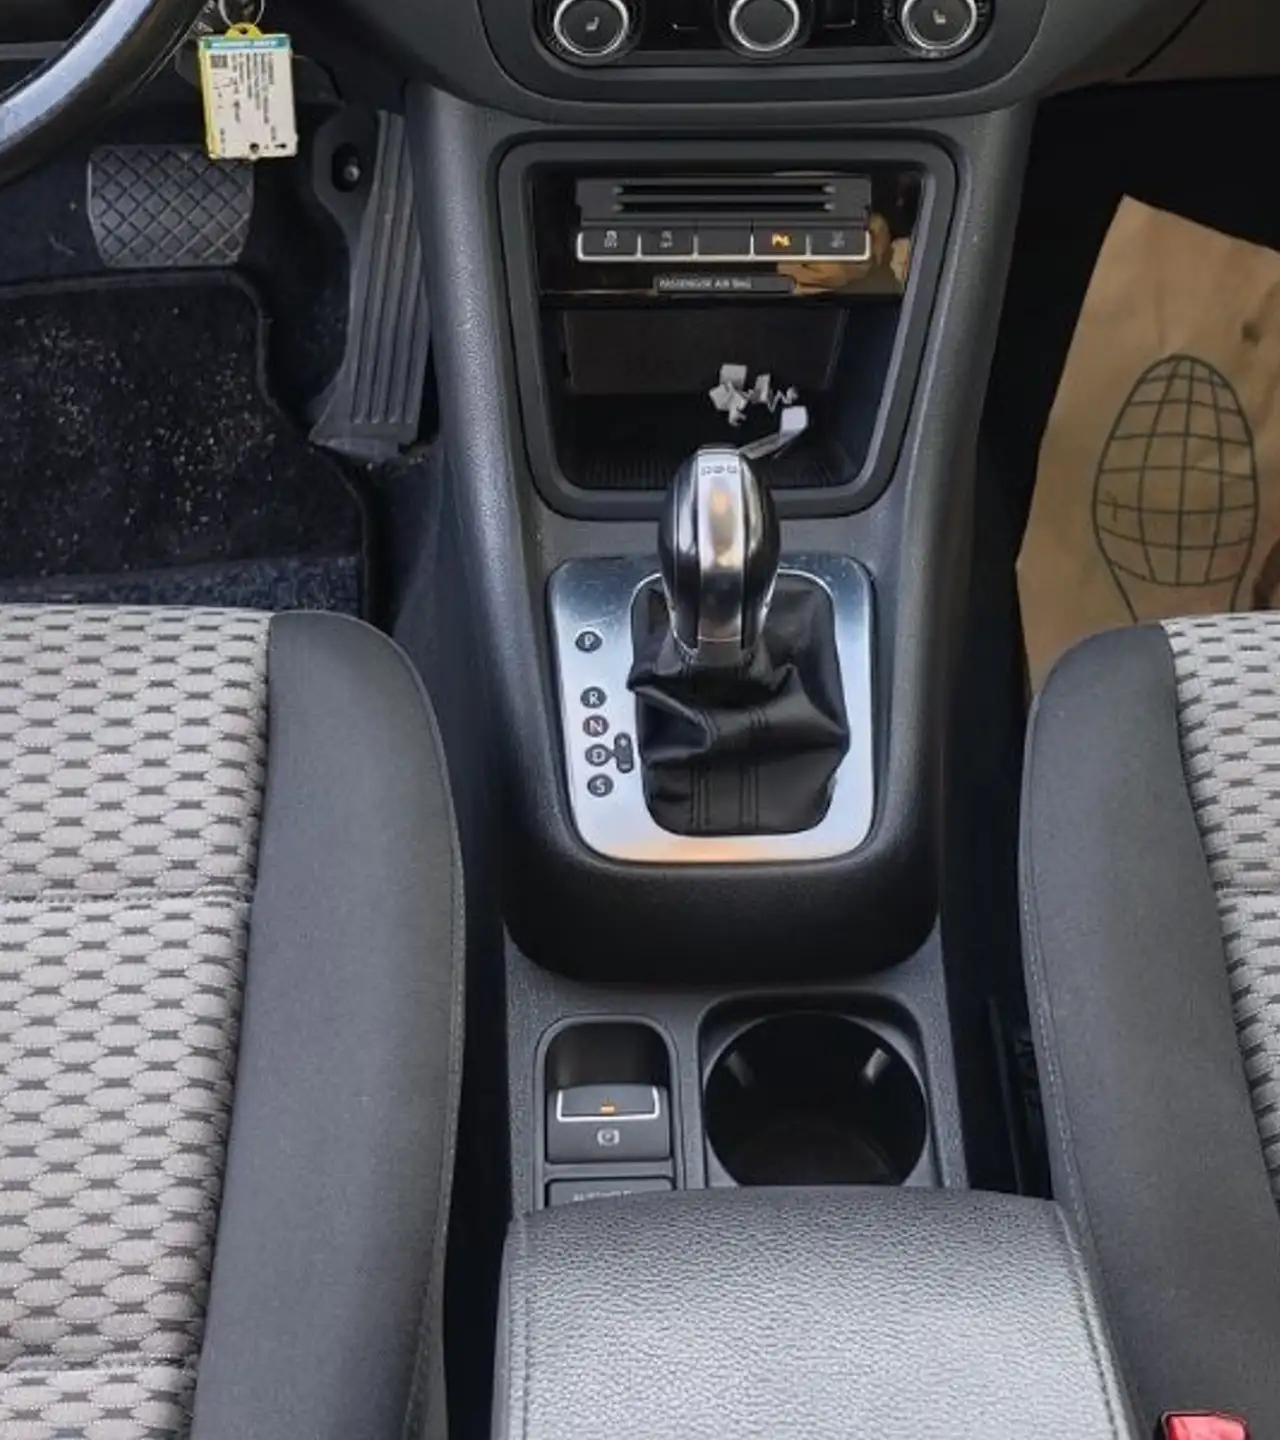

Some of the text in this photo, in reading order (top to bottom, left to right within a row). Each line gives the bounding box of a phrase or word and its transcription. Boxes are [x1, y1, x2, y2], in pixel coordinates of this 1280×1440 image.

[584, 634, 595, 649] P
[588, 691, 600, 705] R
[589, 720, 603, 733] N
[591, 749, 605, 761] D
[595, 779, 606, 794] S
